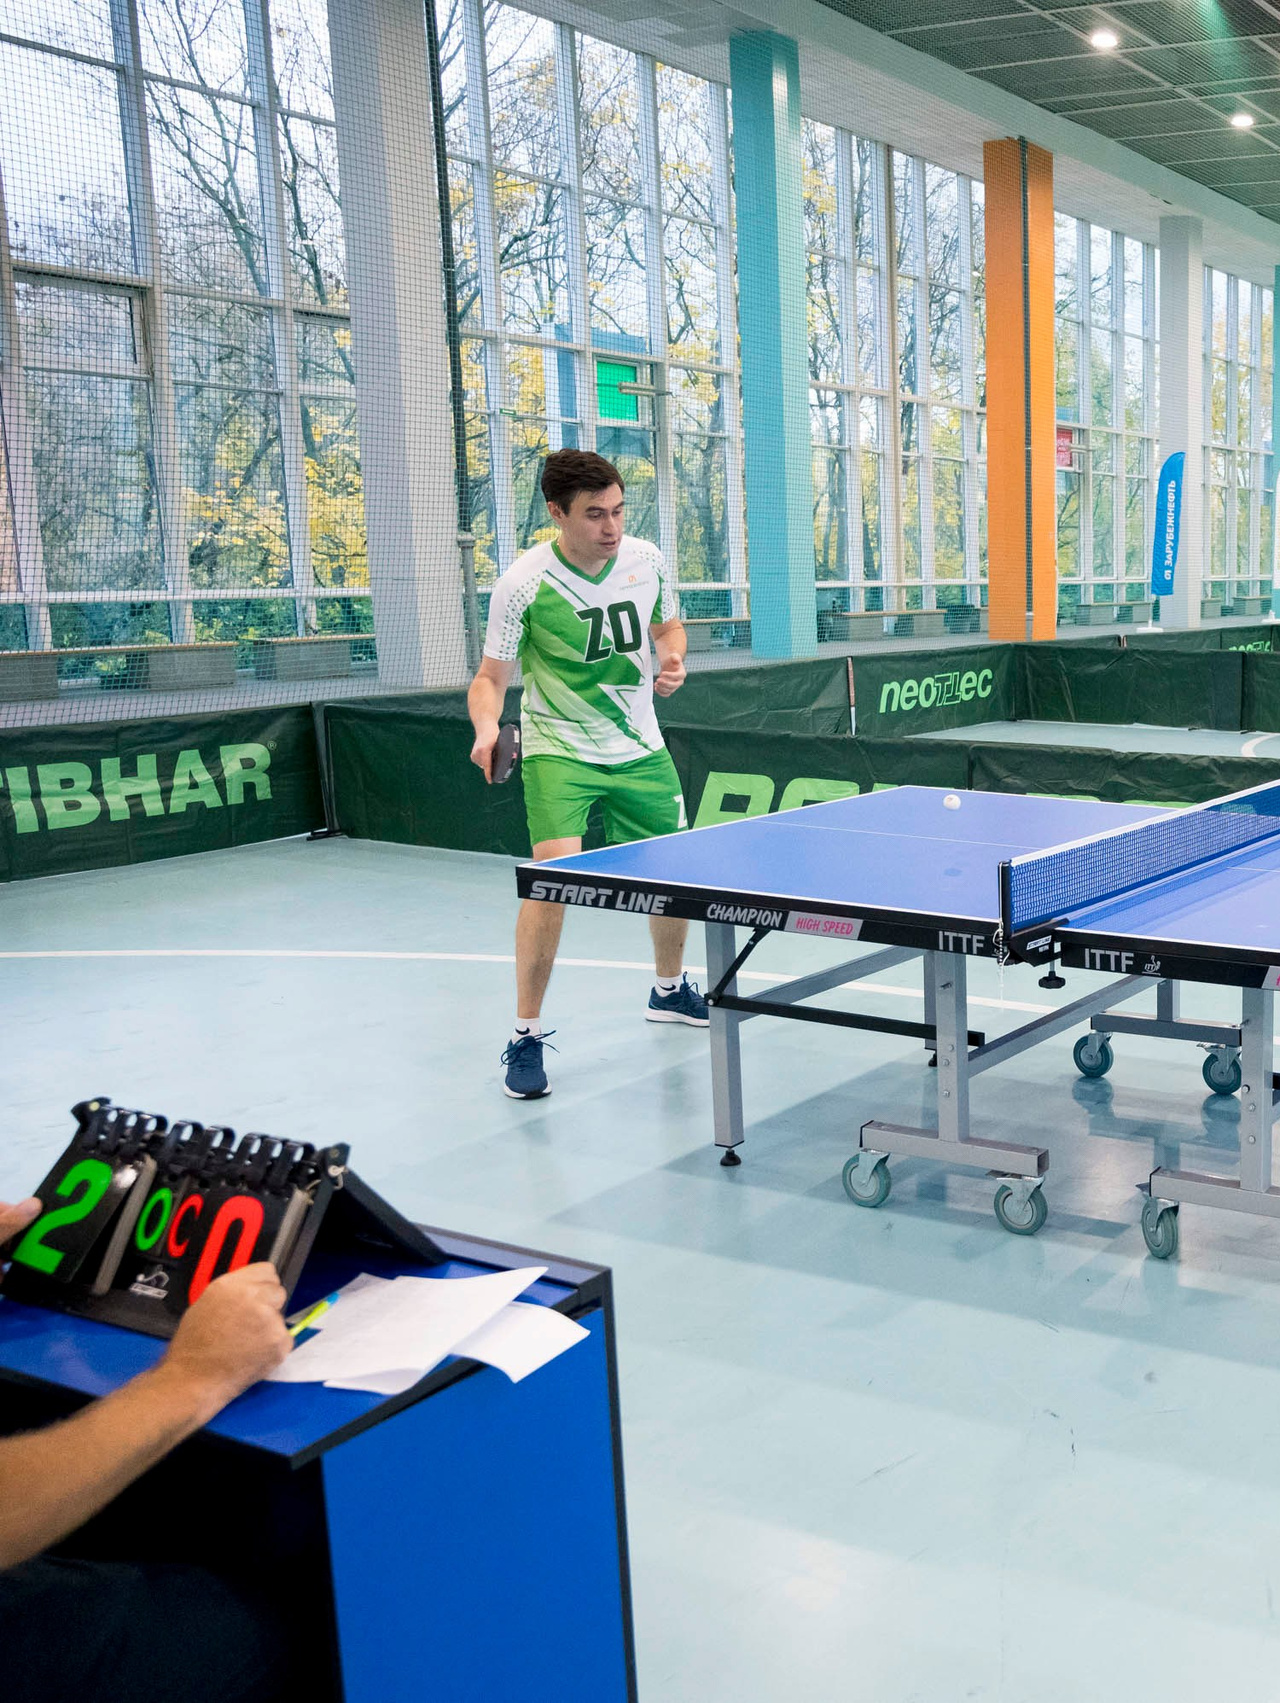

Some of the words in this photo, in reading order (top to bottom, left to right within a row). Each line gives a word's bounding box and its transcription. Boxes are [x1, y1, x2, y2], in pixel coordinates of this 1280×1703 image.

[1164, 480, 1177, 567] ЗАРУБЕЖНЕФТЬ
[0, 742, 273, 834] IBHAR
[529, 880, 613, 908] START
[615, 893, 667, 916] LINE
[706, 903, 783, 928] CHAMPION
[795, 916, 821, 932] HIGH
[823, 919, 854, 935] SPEED
[938, 930, 986, 954] ITTF
[1084, 947, 1135, 973] ITTF
[11, 1158, 113, 1275] 2
